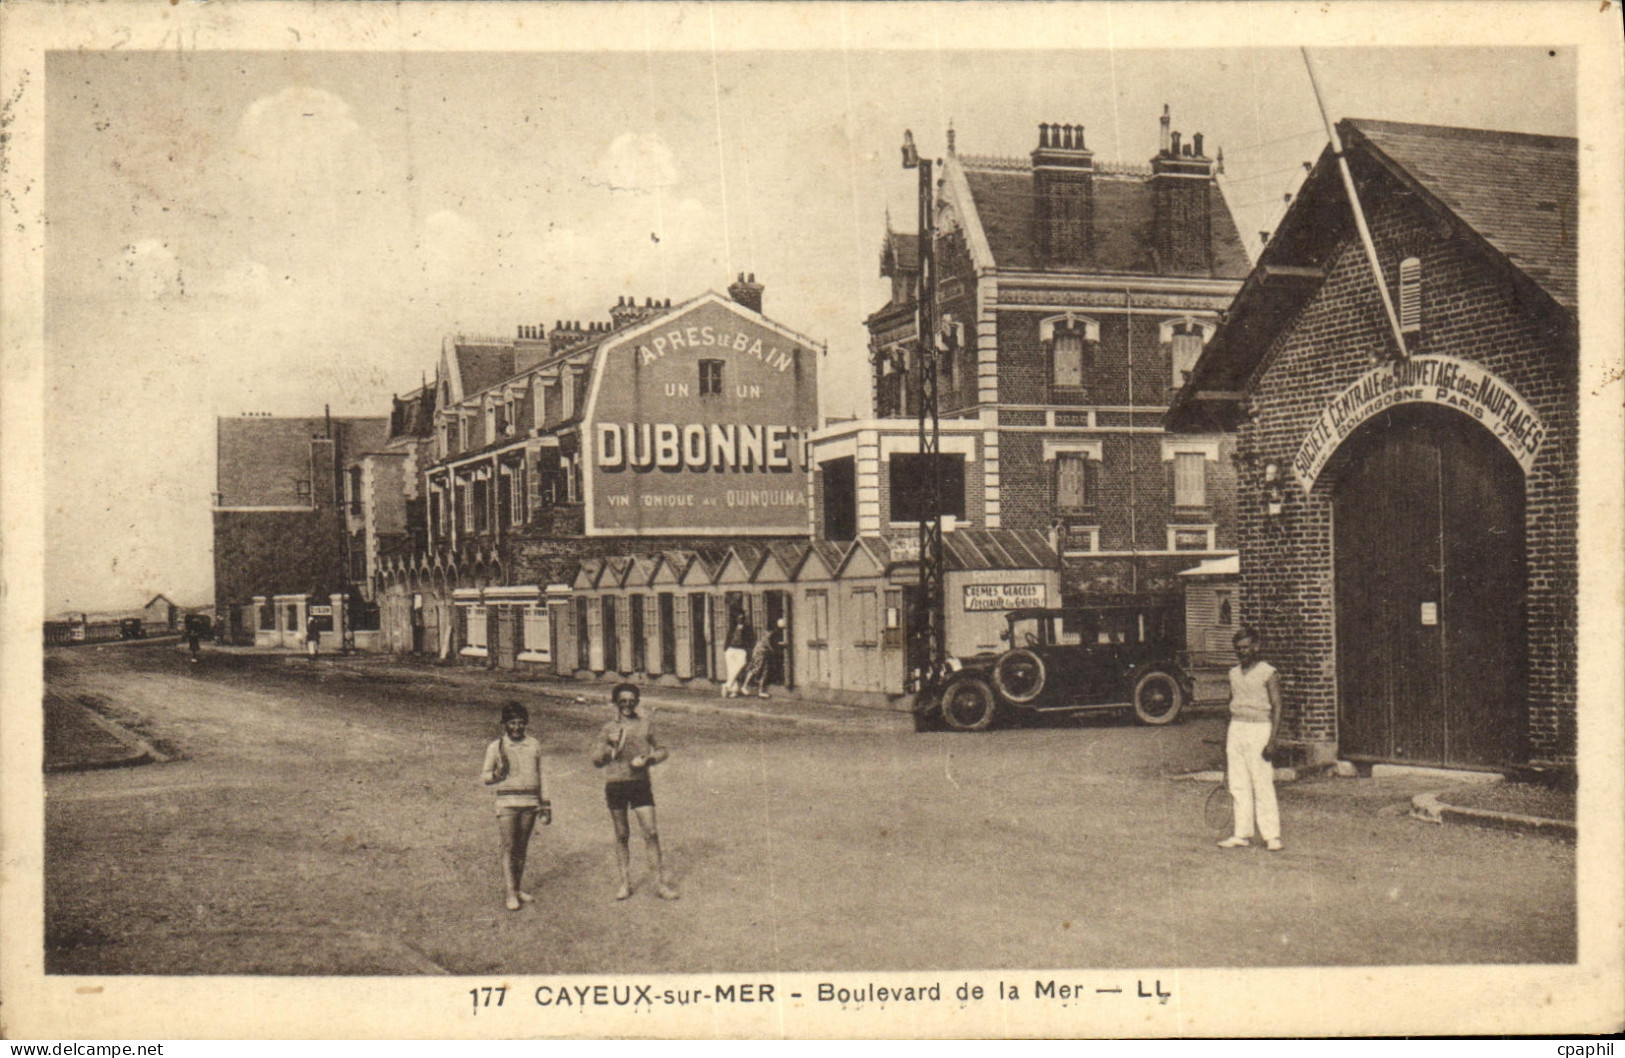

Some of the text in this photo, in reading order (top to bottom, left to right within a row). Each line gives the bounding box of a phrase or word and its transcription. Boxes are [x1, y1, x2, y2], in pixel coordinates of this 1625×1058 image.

[733, 332, 792, 372] BAIN
[665, 383, 760, 398] UN UN
[1328, 371, 1383, 428] CENTRALE
[1381, 373, 1394, 391] de
[1393, 359, 1459, 391] SAUVETAGE
[1456, 373, 1479, 400] des
[1337, 389, 1424, 438] BOURGOGNE
[1435, 388, 1484, 419] PARIS
[608, 494, 630, 506] VIN
[726, 490, 807, 508] QUINQUINA
[470, 980, 1171, 1008] 177 CAYEUX-sur-MER Boulevard de la Mer LL
